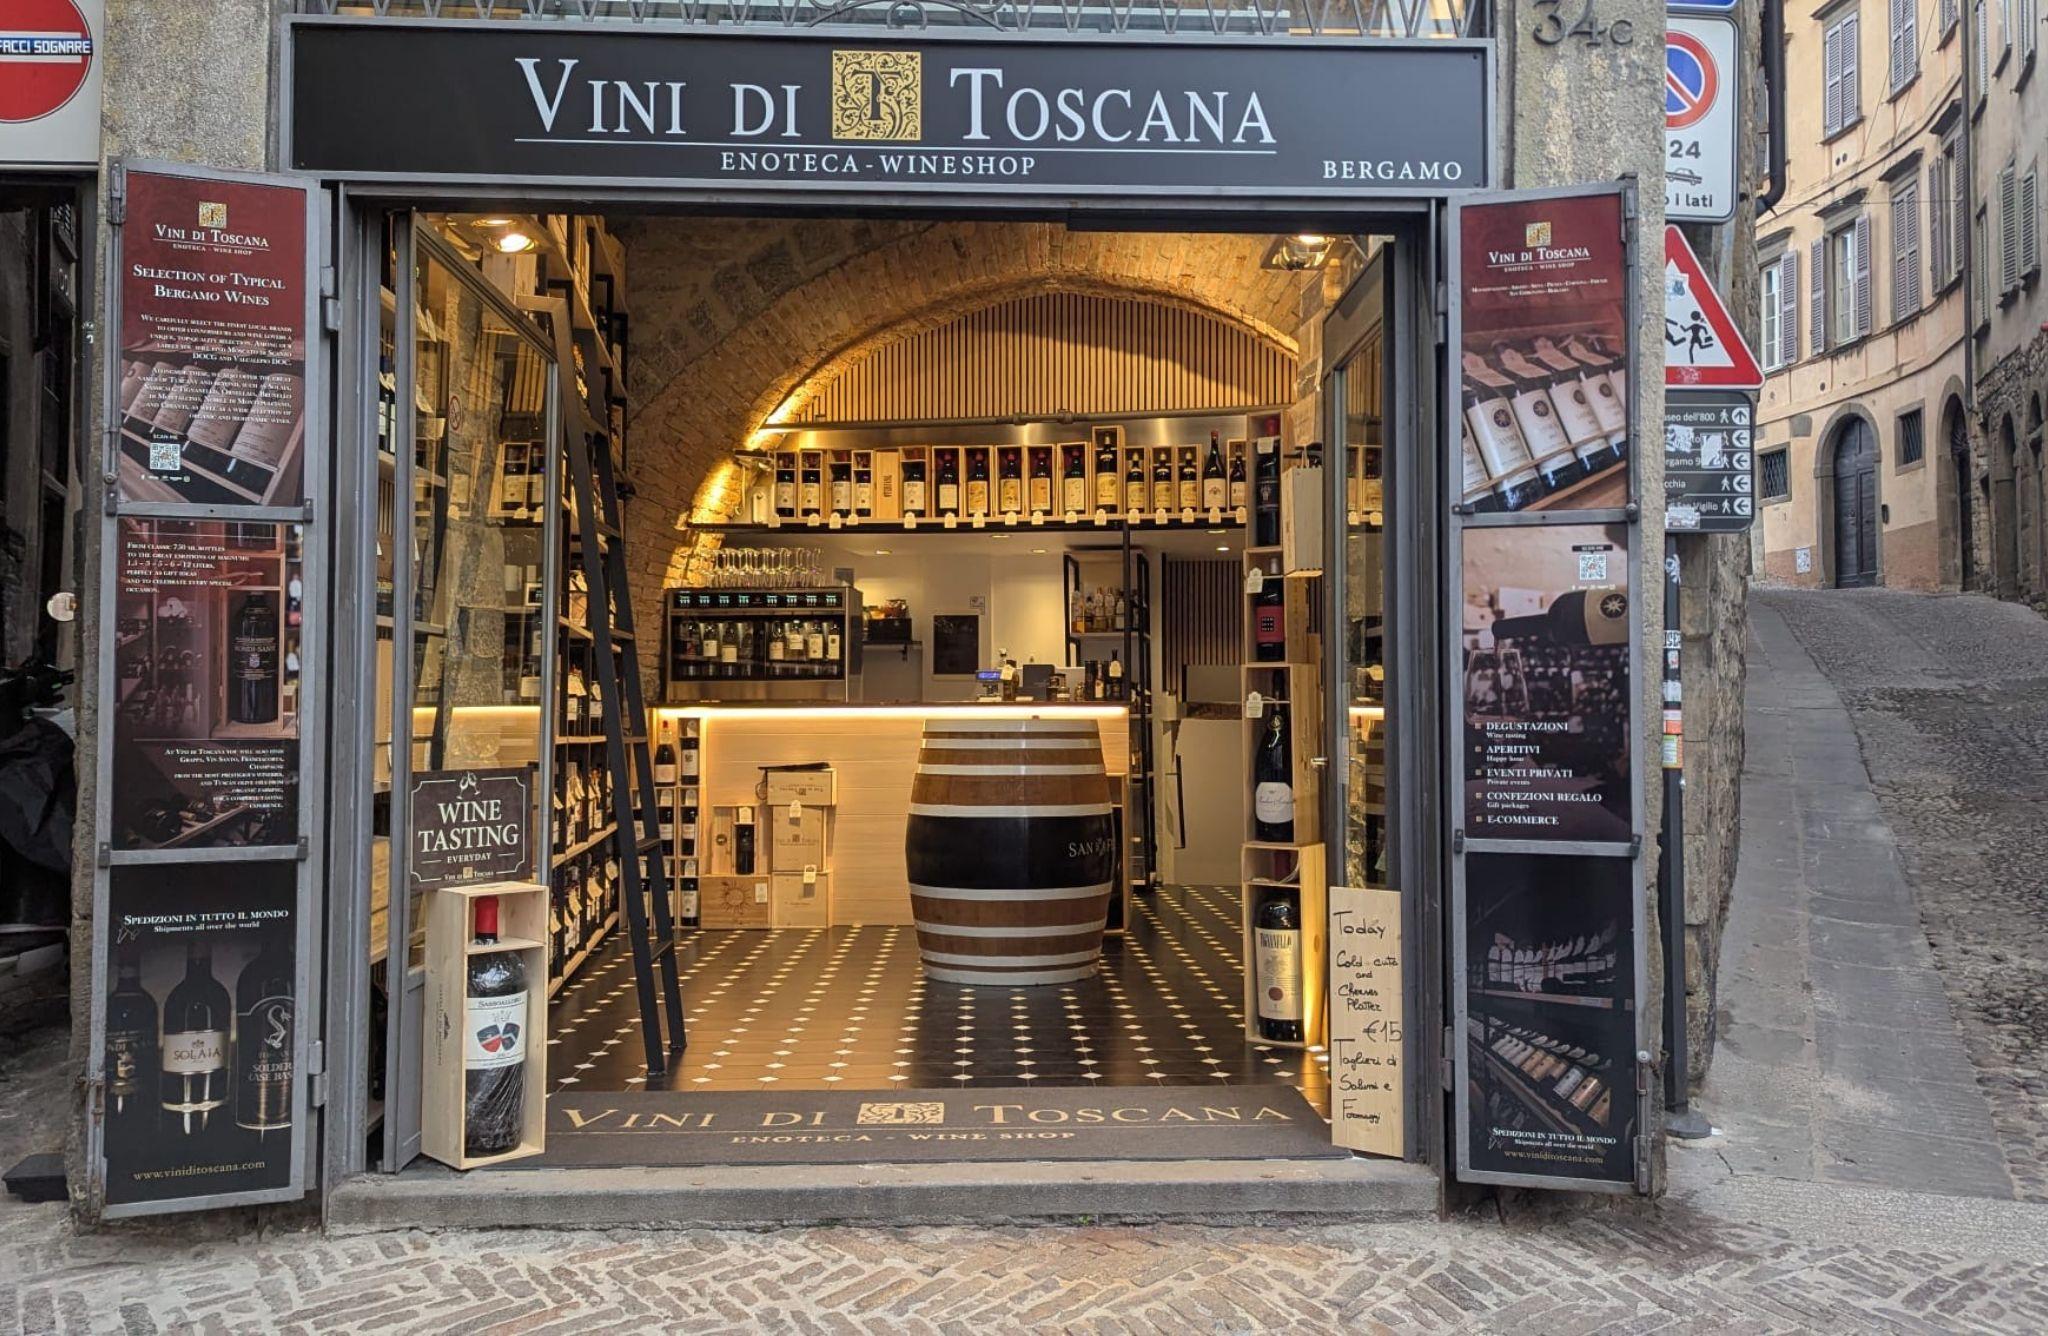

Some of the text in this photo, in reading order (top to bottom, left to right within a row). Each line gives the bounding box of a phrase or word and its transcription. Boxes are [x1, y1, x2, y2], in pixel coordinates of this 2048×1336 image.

[34, 40, 91, 54] SOGNARE
[515, 58, 686, 135] VINI
[729, 83, 802, 136] DI
[949, 67, 1277, 144] TOSCANA
[1669, 139, 1702, 160] 24
[1322, 160, 1462, 180] BERGAMO
[1685, 193, 1713, 208] lati
[192, 230, 205, 241] DI
[210, 229, 269, 247] TOSCANA
[1488, 247, 1590, 264] VINI DI TOSCANA
[133, 264, 285, 289] SELECTION OF TYPICAL
[154, 285, 270, 306] BERGAMO WINES
[1486, 722, 1568, 731] DEGUSTAZIONI
[1486, 745, 1540, 754] APERITIVI
[1487, 769, 1573, 778] EVENTI PRIVATI
[1487, 792, 1602, 802] CONFEZIONI REGALO
[438, 799, 502, 825] WINE
[1487, 815, 1560, 825] E-COMMERCE
[418, 823, 520, 853] TASTING
[447, 852, 492, 864] EVERYDAY
[124, 910, 289, 926] SPEDIZIONI IN TUTTO IL MONDO
[1333, 911, 1387, 939] Today
[1336, 950, 1363, 968] Cold
[1355, 970, 1373, 980] and
[174, 1047, 222, 1061] SOLAIA
[562, 1104, 1294, 1129] VINI DI TOSCANA
[730, 1134, 872, 1144] ENOTECA
[999, 1131, 1076, 1140] SHOP
[1492, 1127, 1535, 1139] SPEDIZIONI
[1548, 1132, 1575, 1141] TUTTO
[1586, 1136, 1617, 1145] MONDO
[133, 1161, 265, 1181] www.viniditoscana.com
